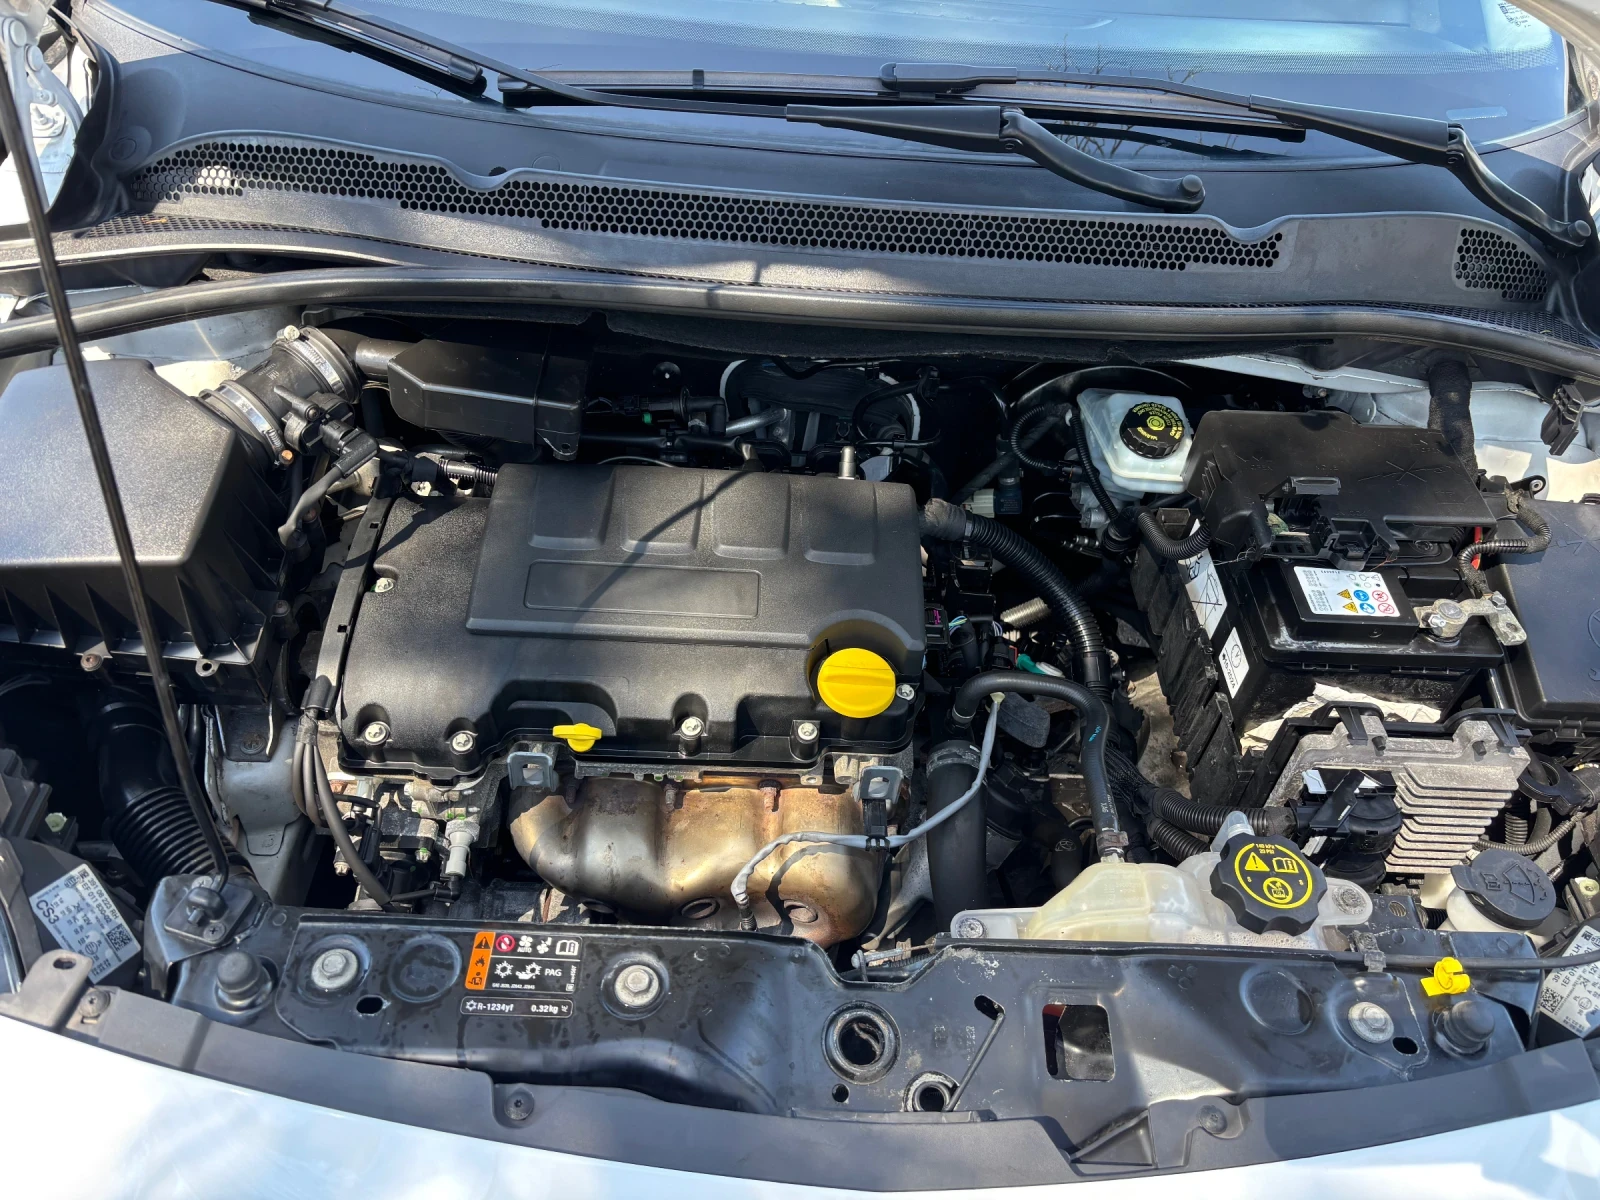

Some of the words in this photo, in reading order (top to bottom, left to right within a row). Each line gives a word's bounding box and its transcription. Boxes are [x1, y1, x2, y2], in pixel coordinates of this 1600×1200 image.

[88, 891, 97, 902] 011
[88, 878, 98, 888] 391
[102, 898, 111, 908] 223
[109, 909, 118, 919] RH
[36, 898, 59, 925] CS3
[82, 914, 91, 925] 12V
[1552, 971, 1561, 982] 391
[1572, 944, 1581, 952] LH
[545, 968, 562, 977] PAG
[1560, 976, 1570, 987] 1EF
[478, 1003, 514, 1012] R-1234yf
[531, 1004, 558, 1014] 0.32kg
